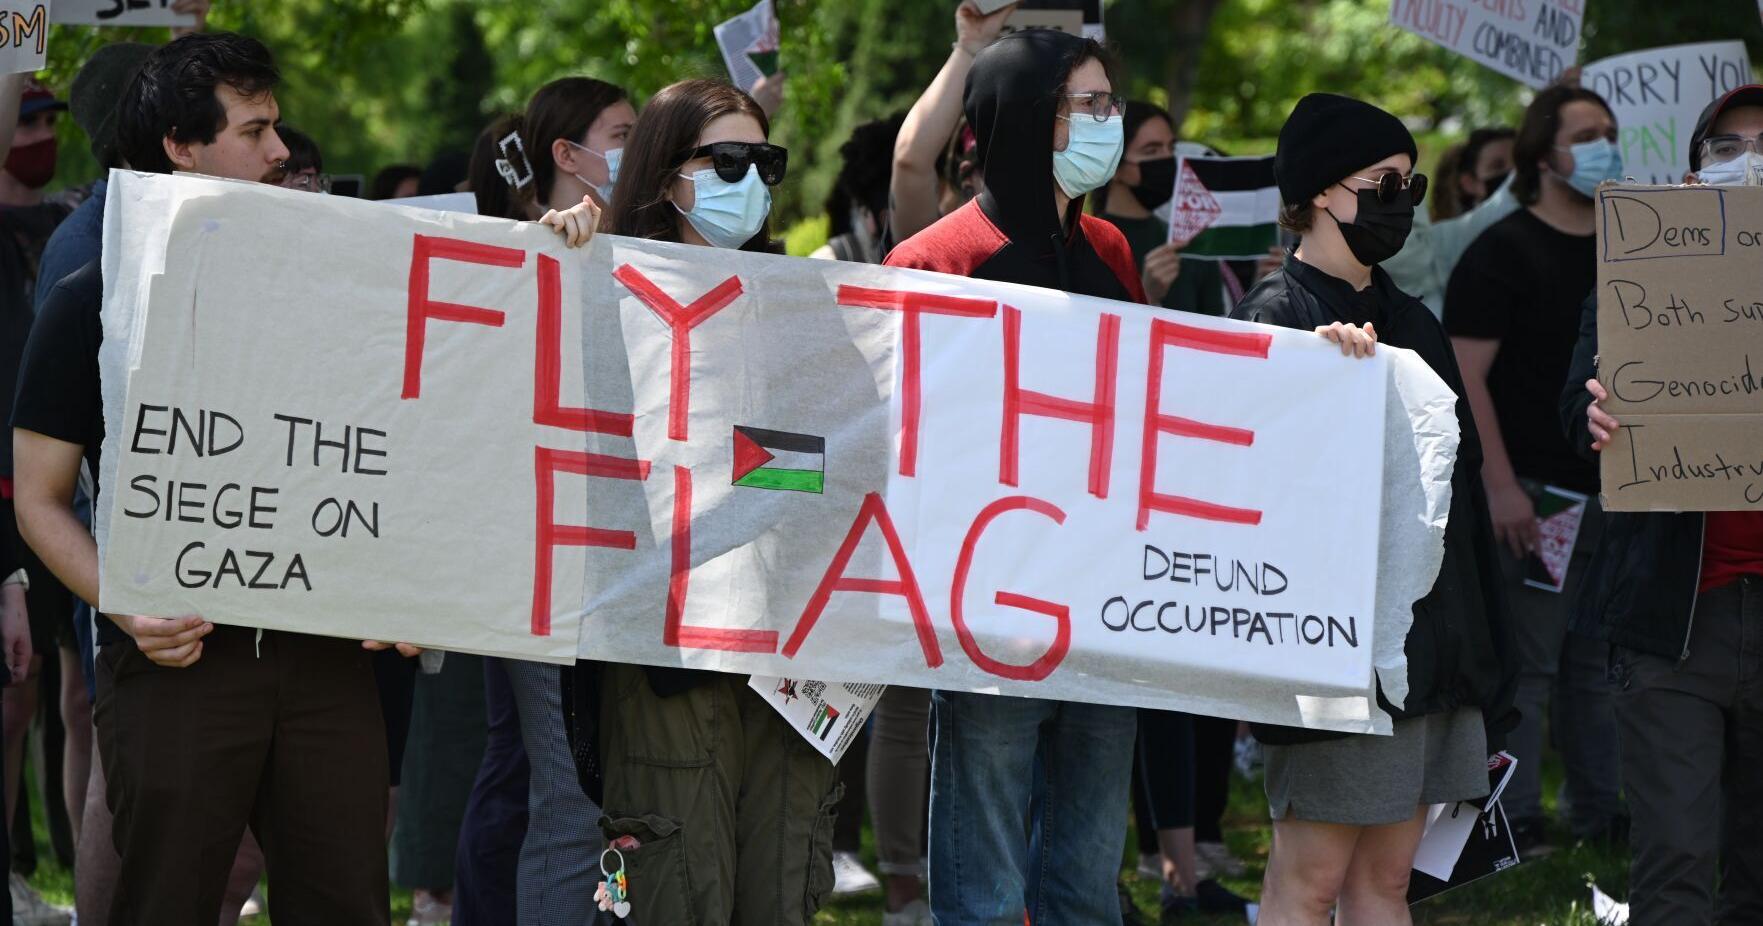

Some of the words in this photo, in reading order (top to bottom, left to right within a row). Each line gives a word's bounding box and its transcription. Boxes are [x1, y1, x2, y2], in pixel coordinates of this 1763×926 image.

[1533, 3, 1576, 47] AND
[1473, 21, 1563, 84] COMBINED
[1584, 58, 1681, 105] ORRY
[1620, 116, 1677, 167] PAY
[1603, 196, 1711, 254] Dems
[1607, 279, 1704, 330] Both
[401, 233, 744, 442] FLY
[837, 284, 1273, 532] THE
[1612, 354, 1763, 403] Genocid
[130, 403, 244, 457] END
[274, 413, 387, 476] THE
[124, 474, 279, 529] SIEGE
[312, 497, 379, 538] ON
[175, 541, 312, 591] GAZA
[531, 446, 1071, 681] FLAG
[1143, 544, 1288, 596] DEFUND
[1101, 595, 1358, 648] OCCUPPATION
